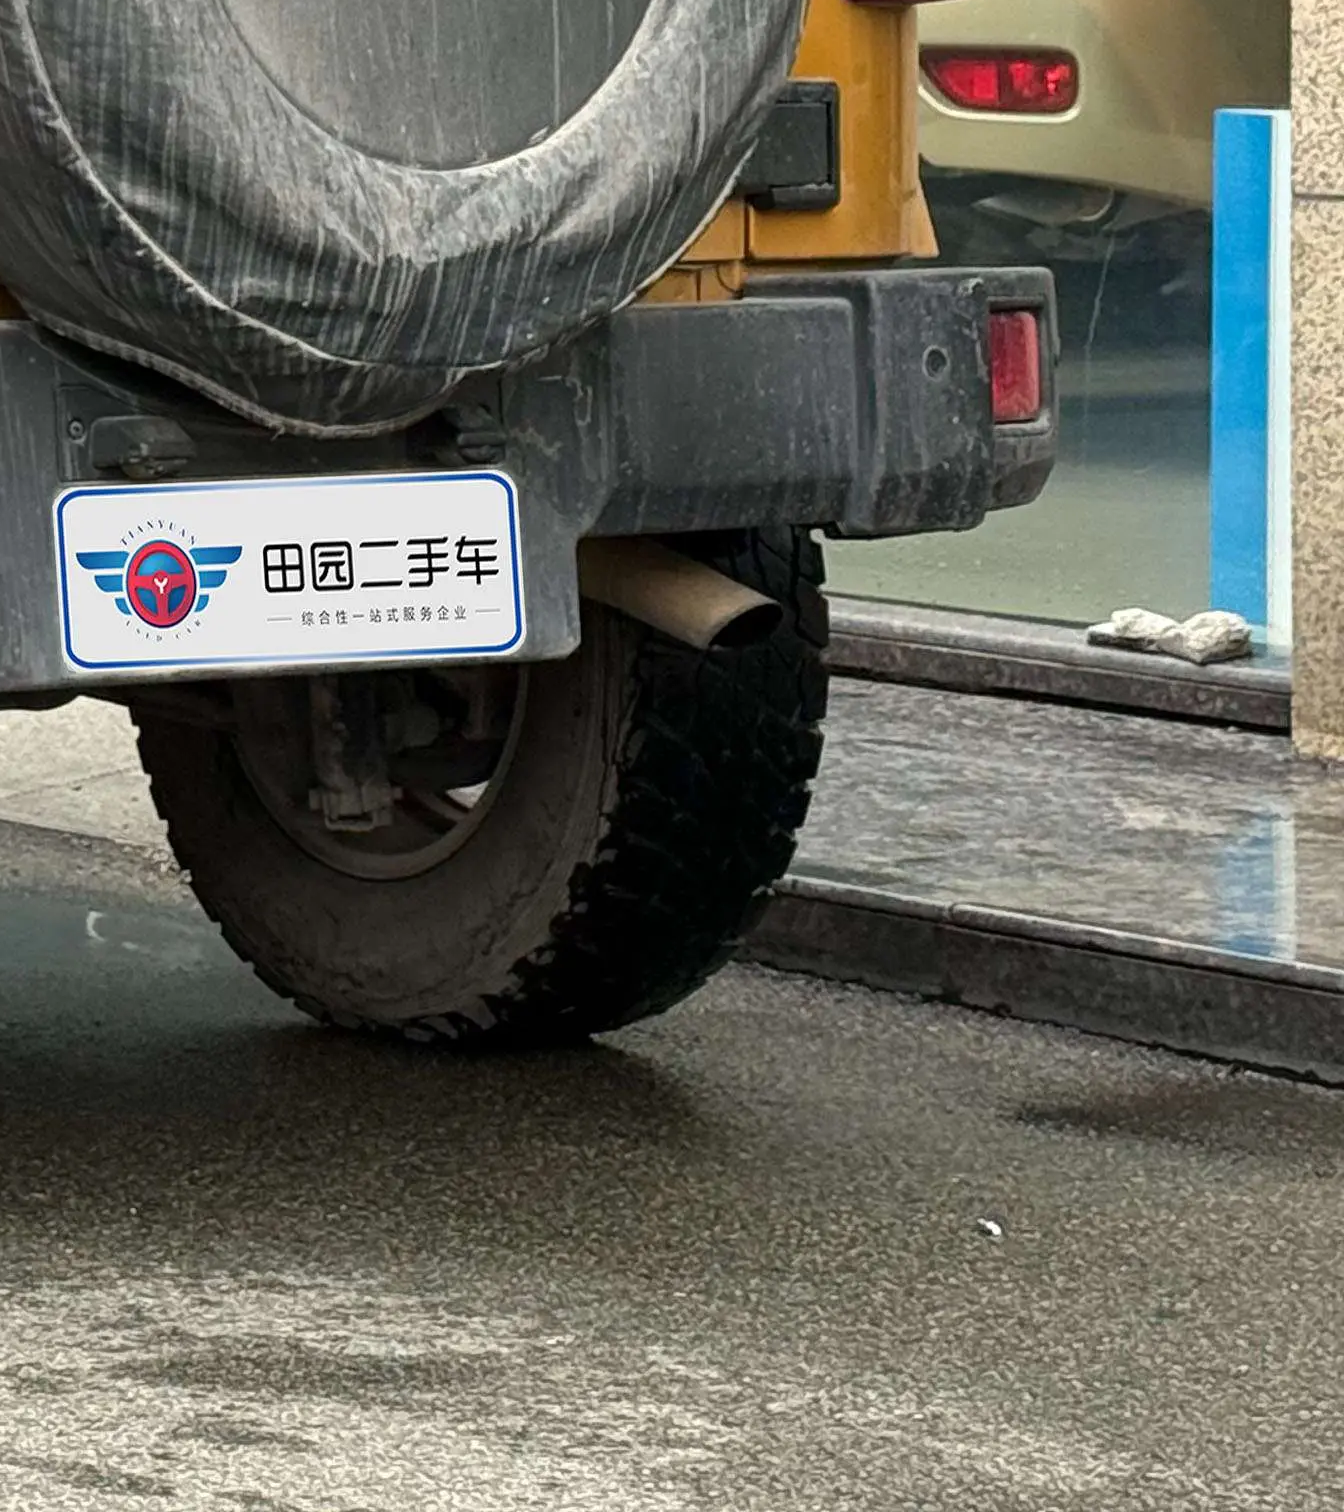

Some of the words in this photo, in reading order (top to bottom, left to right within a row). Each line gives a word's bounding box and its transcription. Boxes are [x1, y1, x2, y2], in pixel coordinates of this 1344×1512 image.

[262, 535, 500, 593] 田园二手车
[301, 604, 467, 627] 综合性一站式服务企业
